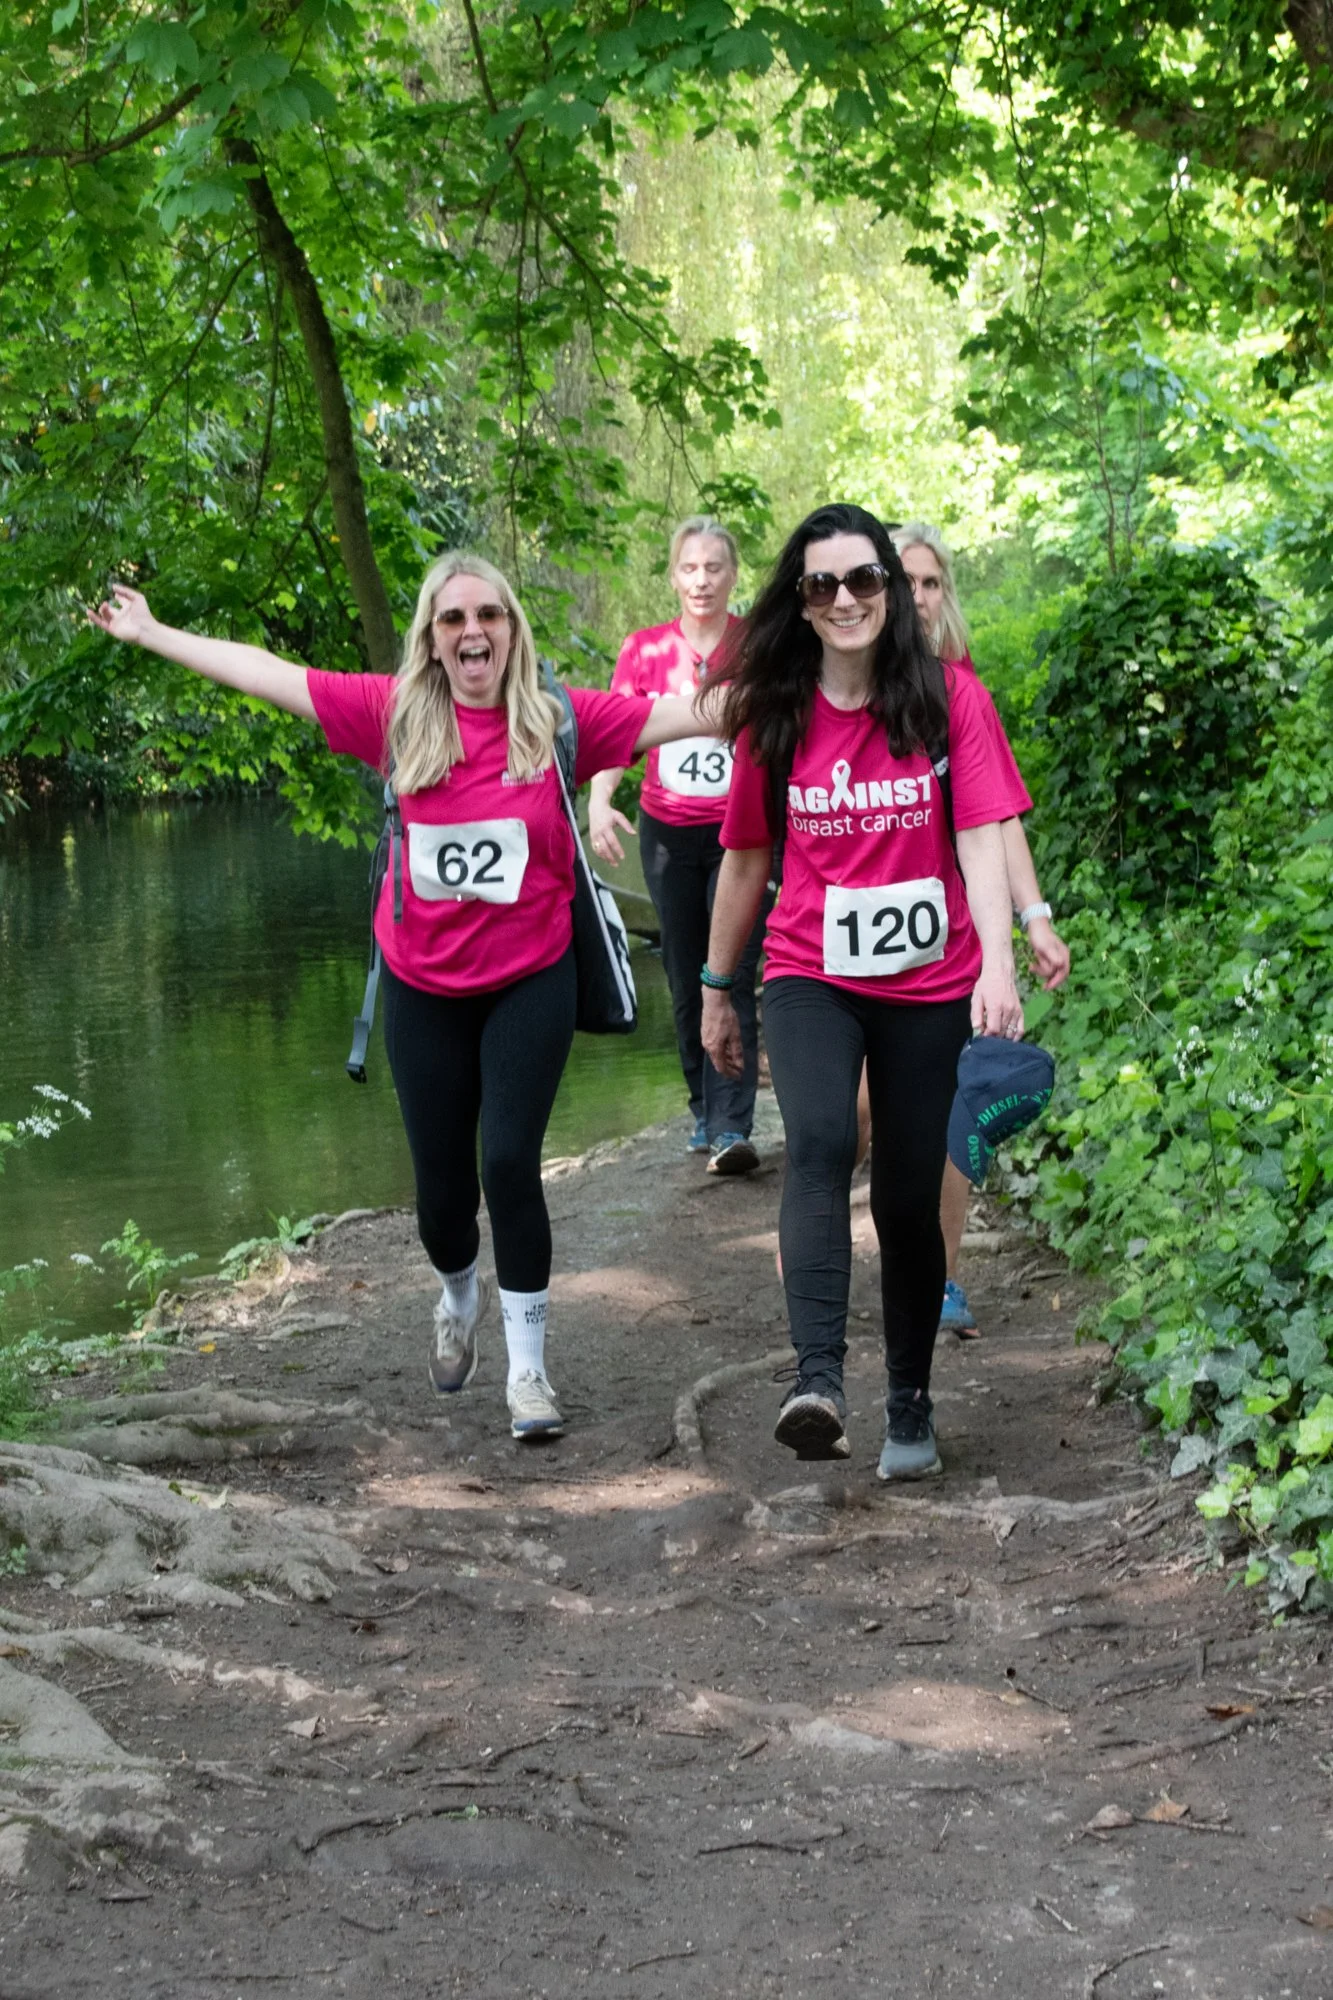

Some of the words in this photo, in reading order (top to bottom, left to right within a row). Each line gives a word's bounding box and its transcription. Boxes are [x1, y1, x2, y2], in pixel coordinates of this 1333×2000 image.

[678, 751, 725, 783] 43
[791, 810, 854, 836] breast
[860, 808, 932, 832] cancer
[436, 839, 504, 886] 62
[837, 900, 940, 956] 120
